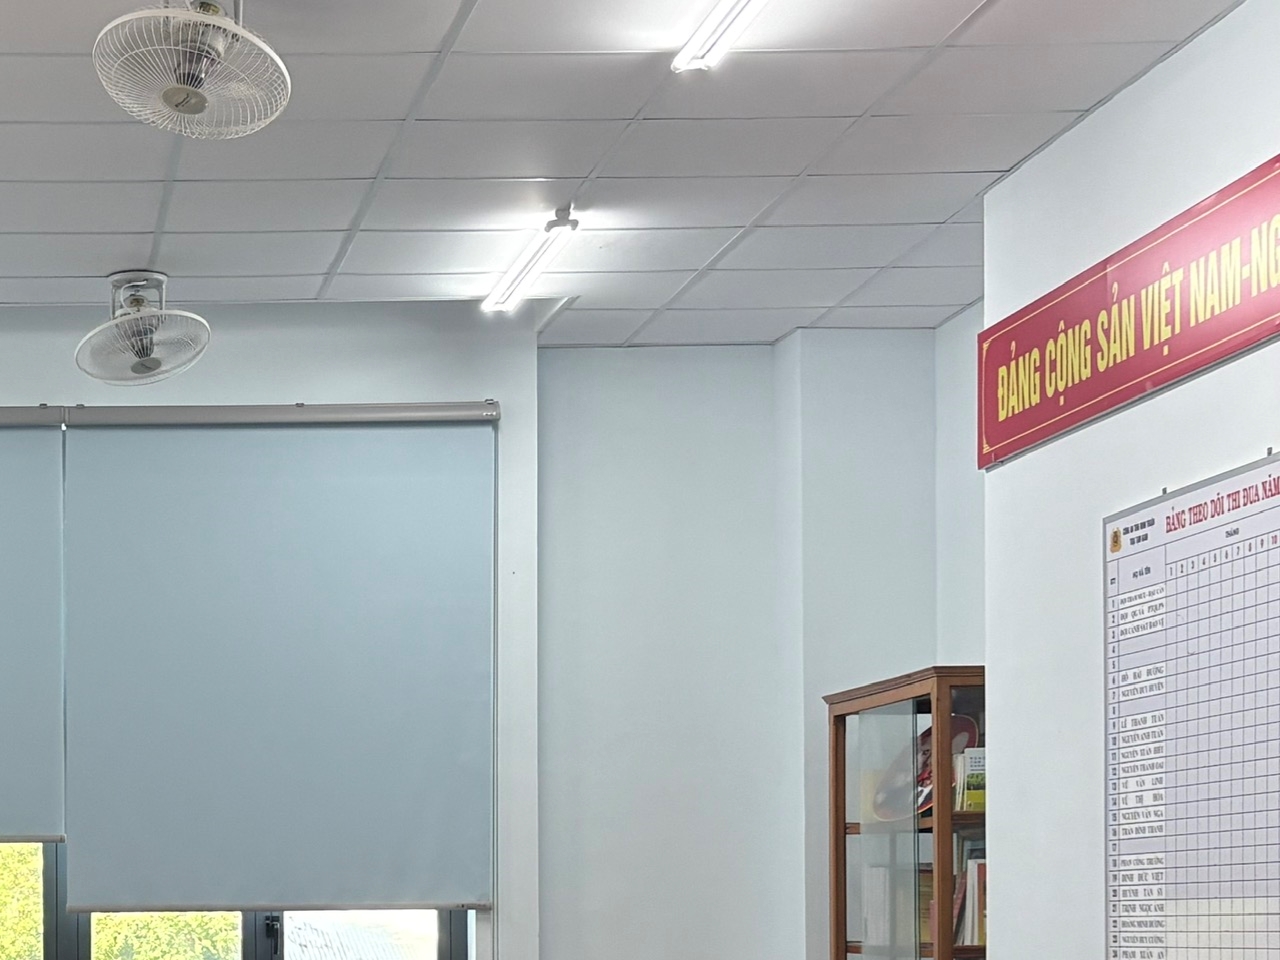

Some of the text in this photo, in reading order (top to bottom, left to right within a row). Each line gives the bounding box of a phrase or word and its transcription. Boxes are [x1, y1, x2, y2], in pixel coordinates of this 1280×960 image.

[997, 340, 1041, 422] ĐẢNG
[1045, 320, 1092, 406] CỘNG
[1096, 281, 1136, 373] SẢN
[1140, 261, 1185, 356] VIỆT
[1166, 507, 1187, 533] BẢNG
[1188, 502, 1208, 526] THEO
[1226, 488, 1241, 511] THI
[1242, 484, 1260, 507] ĐUA
